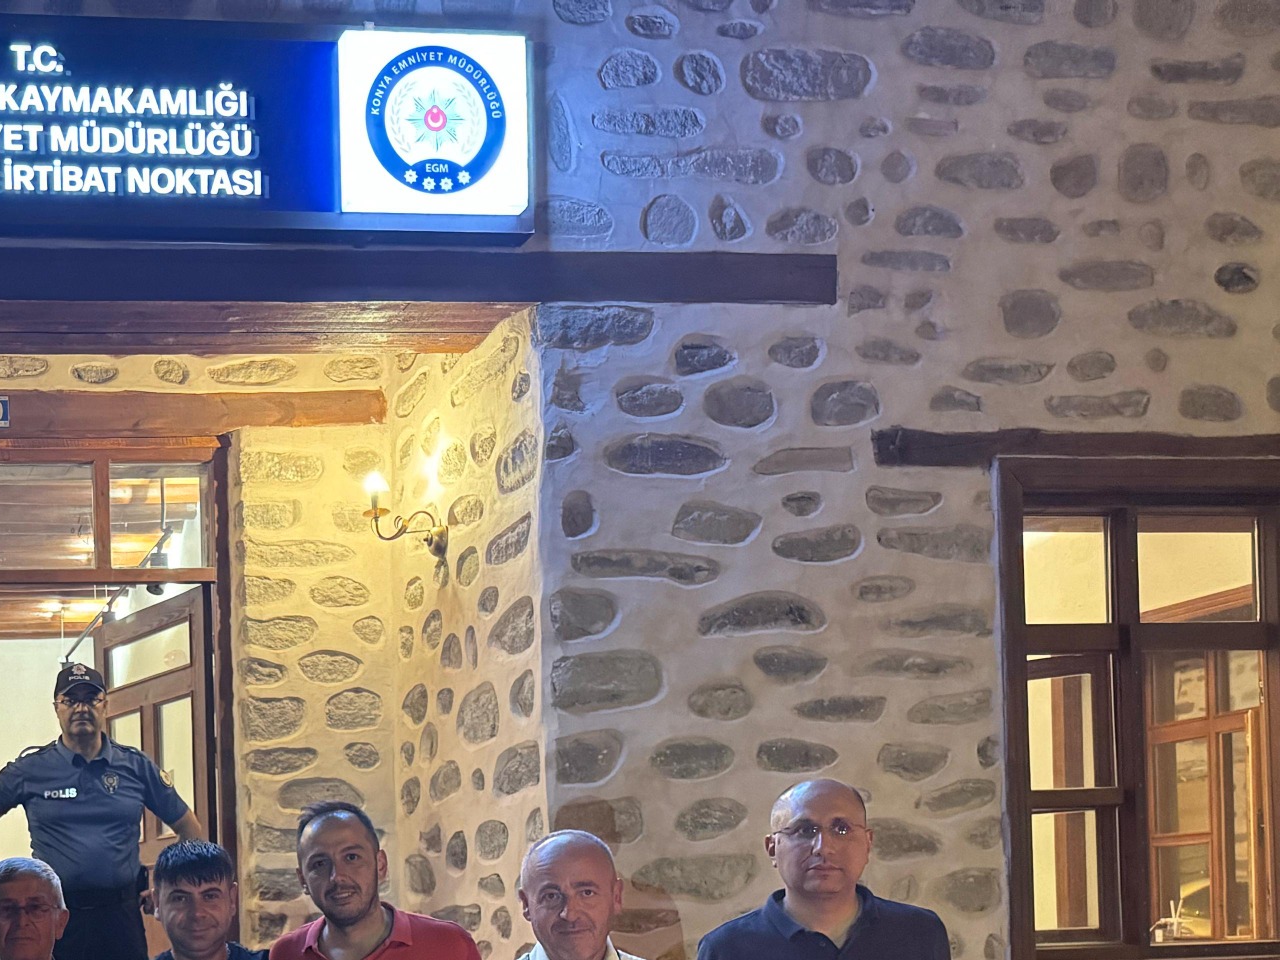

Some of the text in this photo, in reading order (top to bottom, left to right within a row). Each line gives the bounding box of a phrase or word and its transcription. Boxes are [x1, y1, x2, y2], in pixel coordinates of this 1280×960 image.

[9, 44, 64, 72] T.C.
[371, 51, 503, 119] KONYA EMNİYET MÜDÜRLÜĞÜ
[50, 119, 252, 157] MÜDÜRLÜĞÜ
[4, 158, 122, 193] İRTİBAT
[127, 167, 262, 196] NOKTASI
[425, 163, 449, 173] EGM
